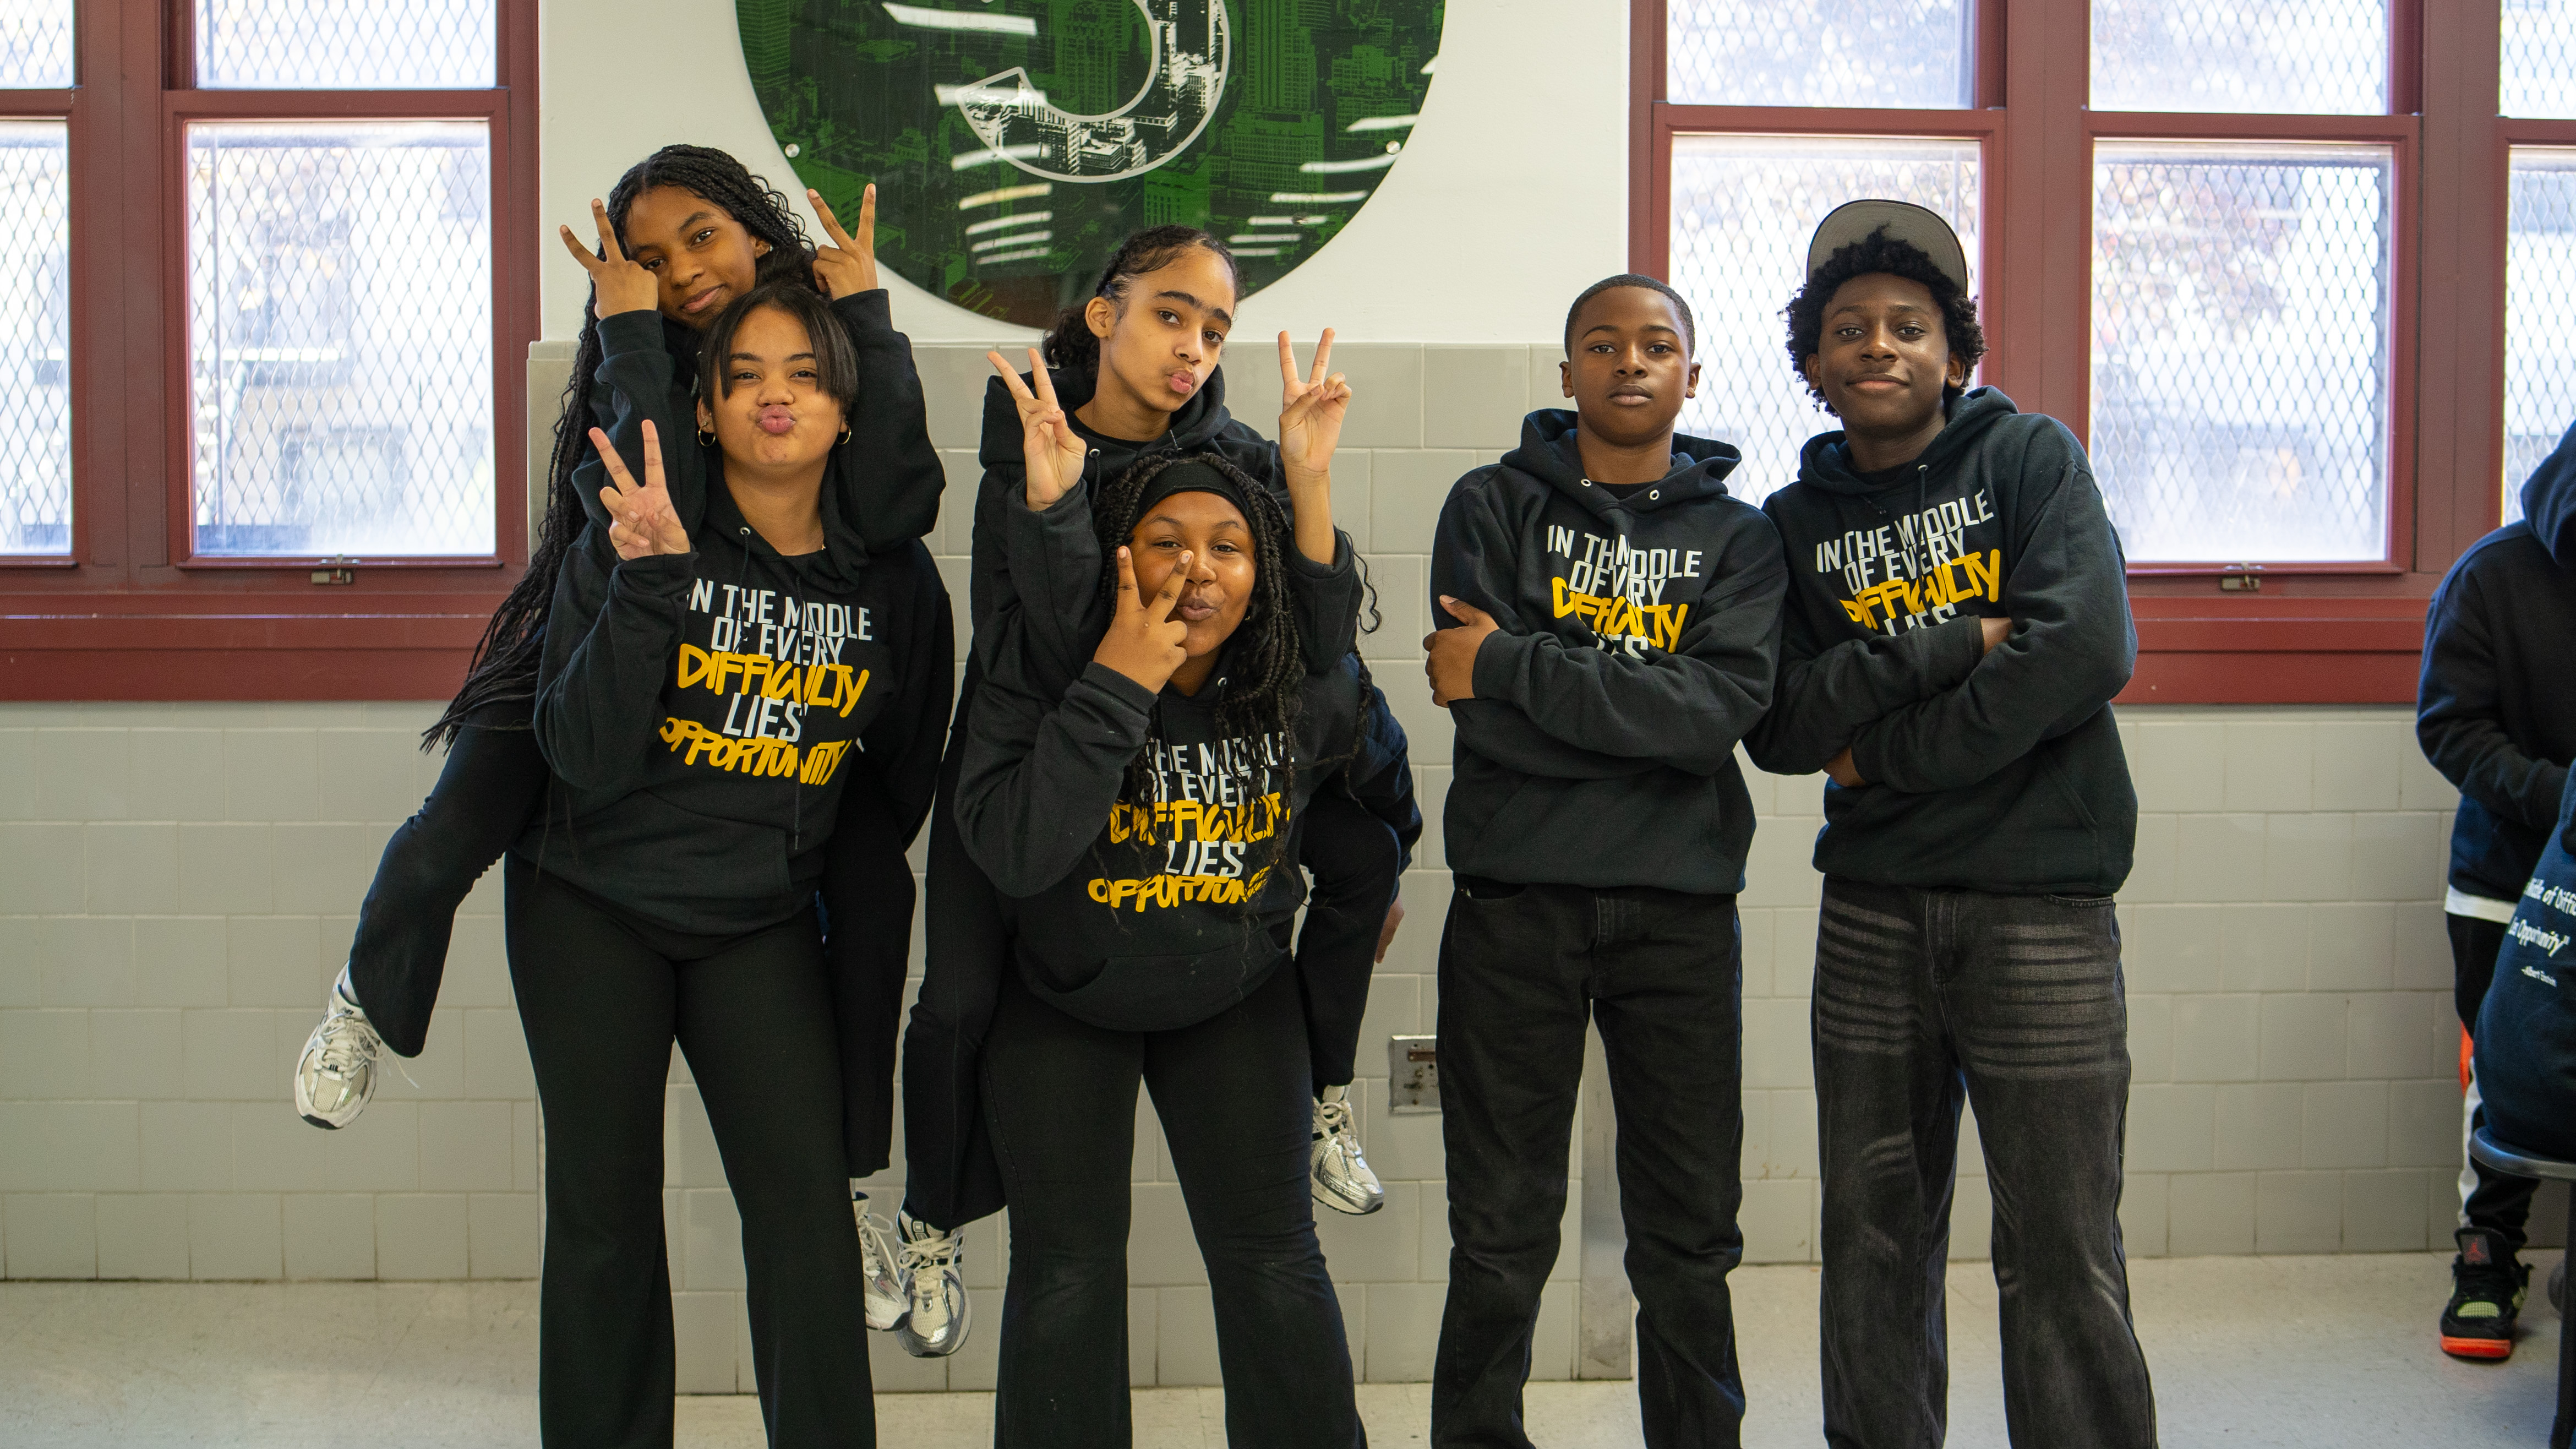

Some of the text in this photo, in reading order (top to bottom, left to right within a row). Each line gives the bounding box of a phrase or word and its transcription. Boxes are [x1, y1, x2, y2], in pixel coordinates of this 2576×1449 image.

[1547, 525, 1702, 580] IN TH MDDLE
[1817, 539, 1841, 573] IN
[1844, 525, 1895, 563] THE
[686, 578, 714, 613] N
[722, 584, 776, 624] THE
[1569, 560, 1667, 611] OF VRY
[1844, 557, 1874, 596] OF
[711, 616, 845, 669] OF EVERY
[678, 643, 870, 718] DIFFICULTY
[722, 692, 809, 743] LIES
[659, 717, 853, 786] OPPORTUNITY
[1165, 840, 1246, 878] LIES
